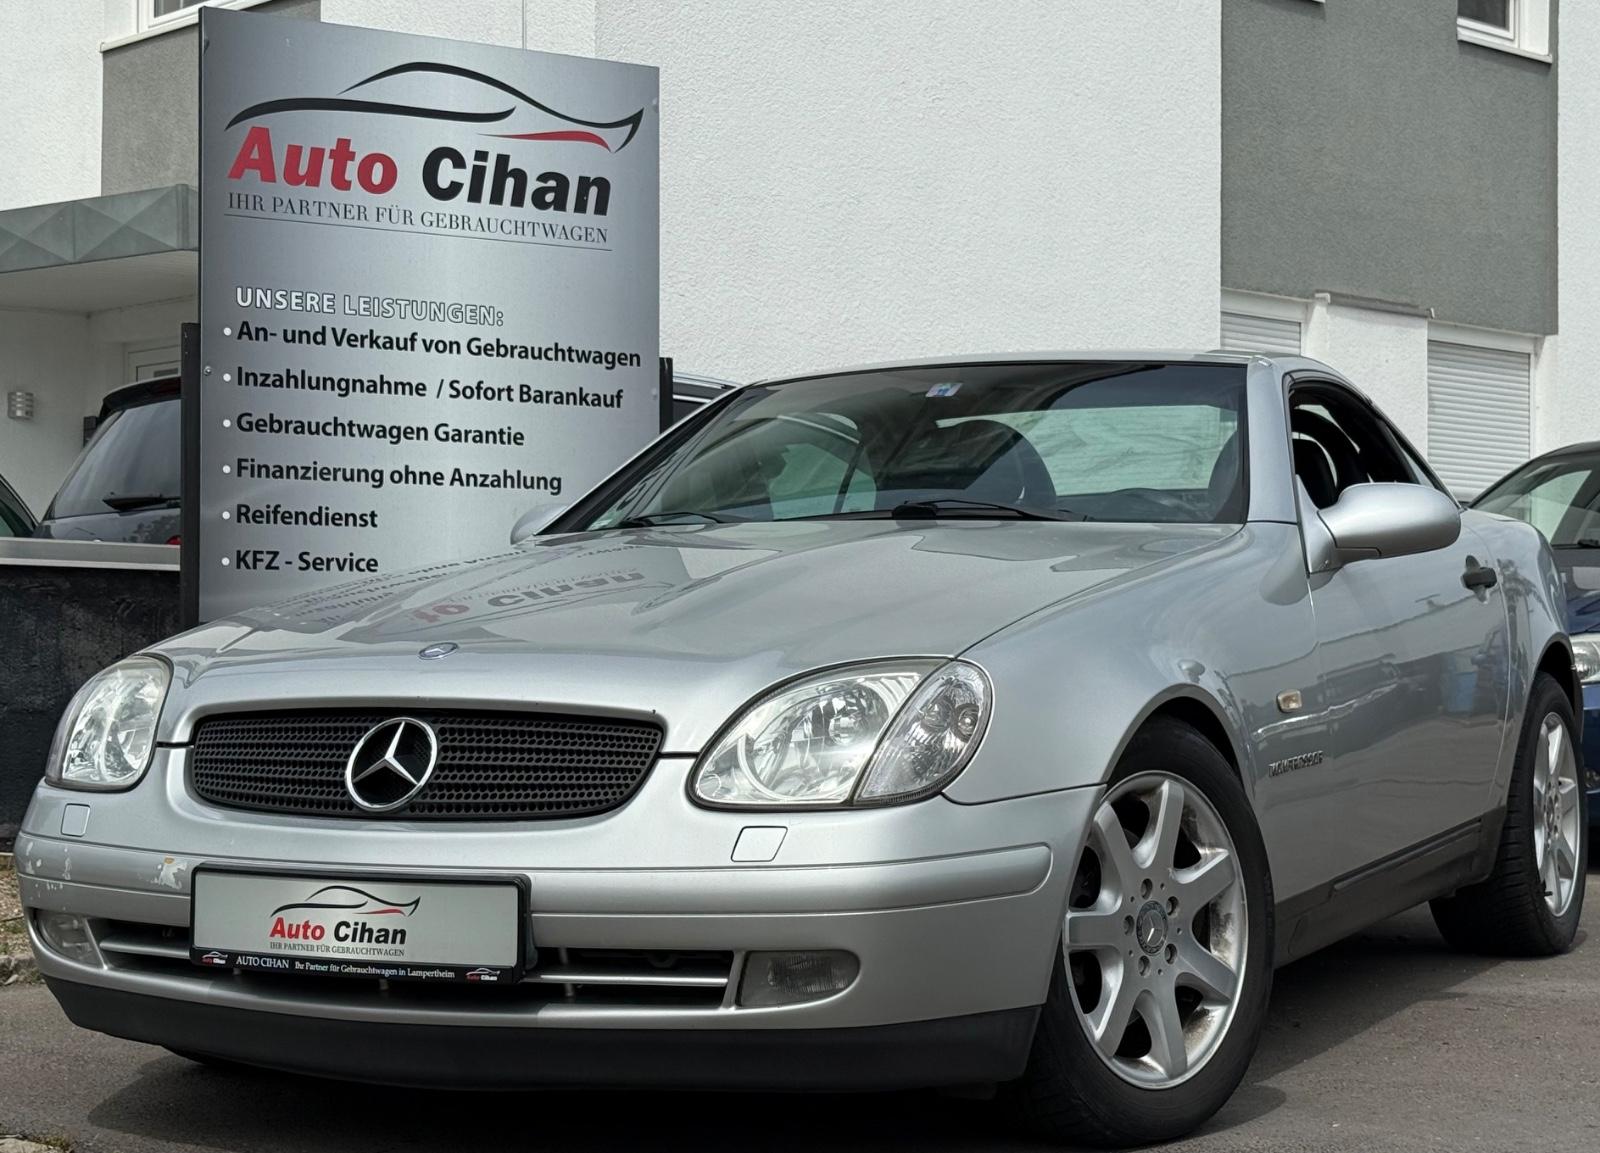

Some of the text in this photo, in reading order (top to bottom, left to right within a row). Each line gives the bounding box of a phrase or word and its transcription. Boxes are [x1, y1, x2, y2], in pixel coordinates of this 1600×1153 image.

[228, 126, 612, 217] Auto Cihan
[229, 192, 608, 244] IHR PARTNER FÜR GEBRAUCHTWAGEN
[236, 287, 504, 326] UNSERE LEISTUNGEN:
[236, 321, 641, 370] An- und Verkauf von Gebrauchtwagen
[237, 366, 427, 397] Inzahlungnahme
[519, 384, 624, 409] Barankauf
[236, 412, 525, 446] Gebrauchtwagen Garantie
[236, 458, 562, 495] Finanzierung ohne Anzahlung
[236, 504, 378, 528] Reifendienst
[236, 550, 280, 570] KFZ
[298, 551, 379, 573] Service
[270, 917, 407, 945] Auto Cihan
[283, 942, 315, 952] PARTNER
[316, 944, 331, 953] FÜR
[331, 945, 405, 957] GEBRAUCHTWAGEN
[236, 956, 260, 967] AUTO
[260, 957, 290, 969] CIHAN
[305, 962, 329, 972] Partner
[330, 963, 340, 972] für
[340, 964, 398, 977] Gebrauchtwagen
[399, 967, 406, 976] in
[407, 968, 455, 979] Lampertheim
